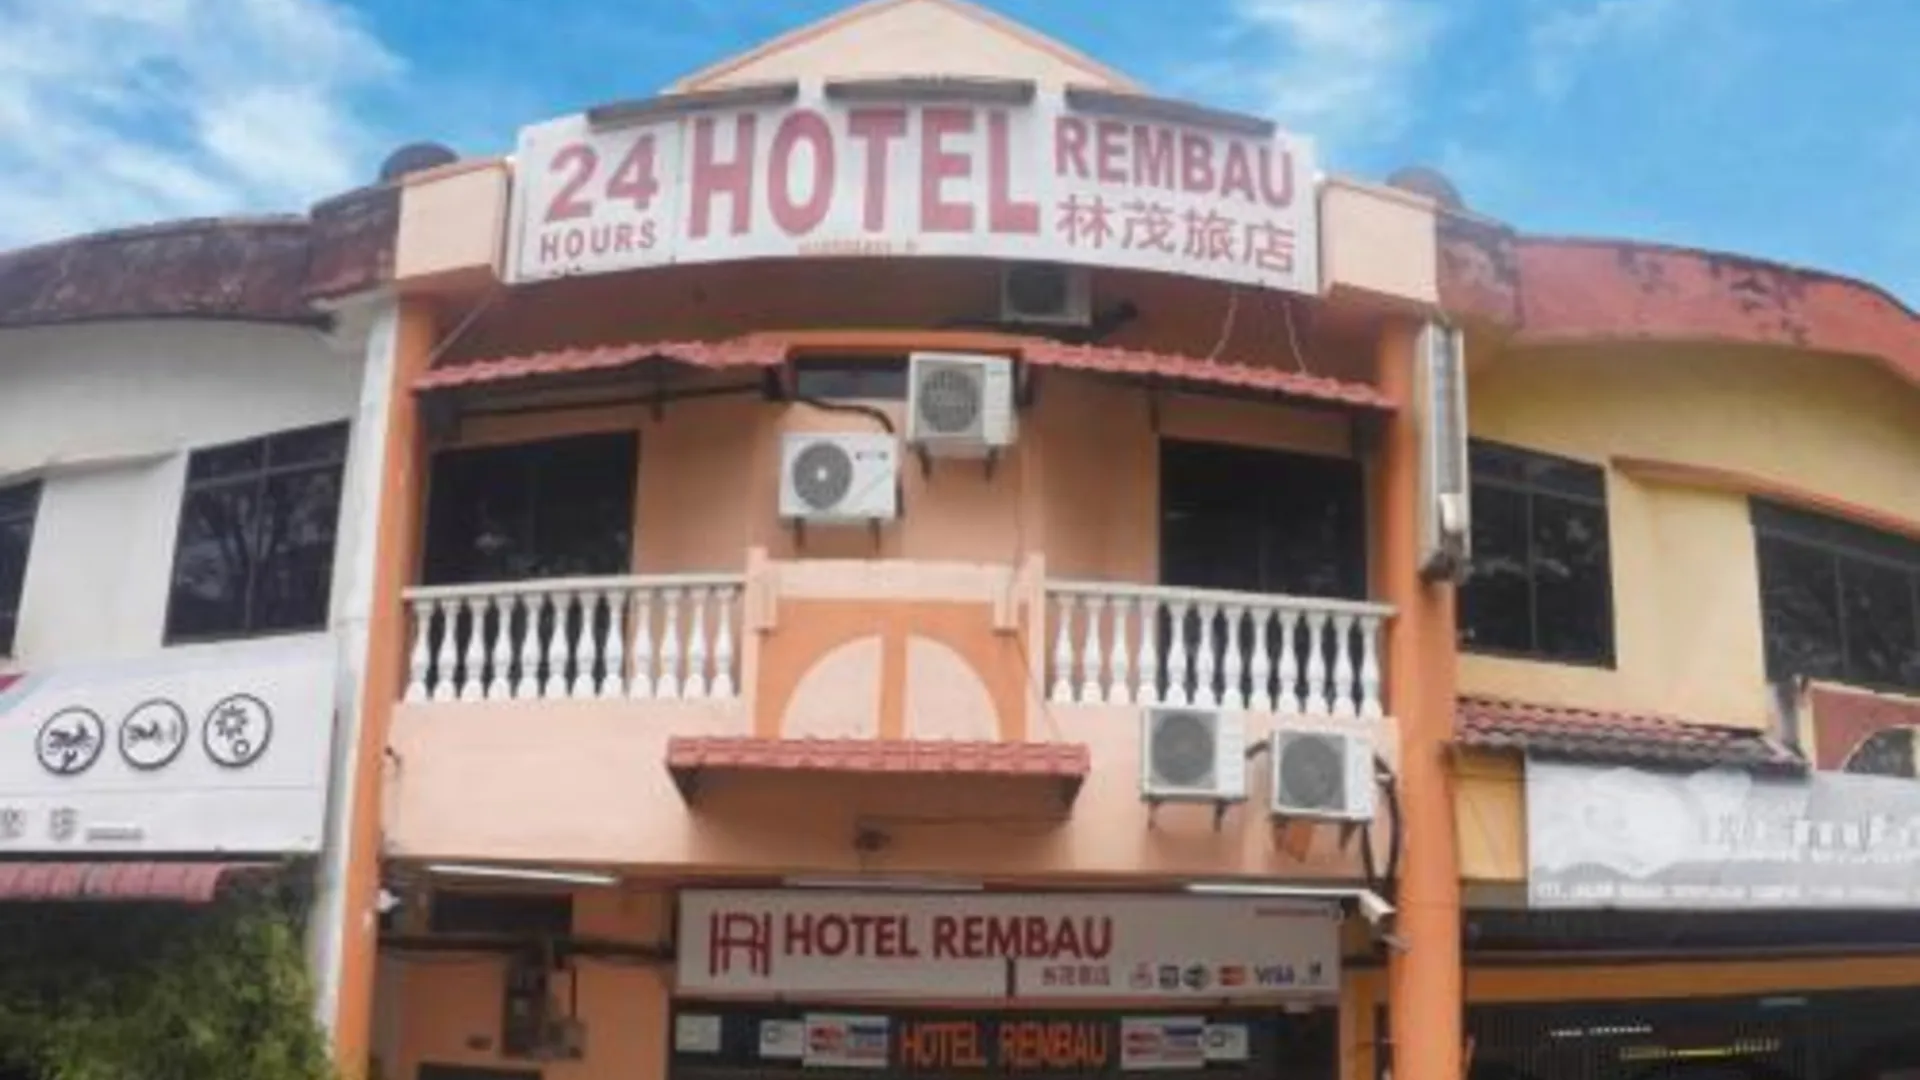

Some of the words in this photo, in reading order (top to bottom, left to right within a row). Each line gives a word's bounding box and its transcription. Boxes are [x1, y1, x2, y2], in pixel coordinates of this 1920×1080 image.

[545, 132, 658, 222] 24
[687, 108, 1042, 238] HOTEL
[1053, 116, 1294, 208] REMBAU
[539, 220, 656, 264] HOURS
[1056, 194, 1295, 272] 林茂旅店
[784, 913, 918, 957] HOTEL
[932, 915, 1112, 960] REMBAU
[901, 1021, 985, 1067] HOTEL
